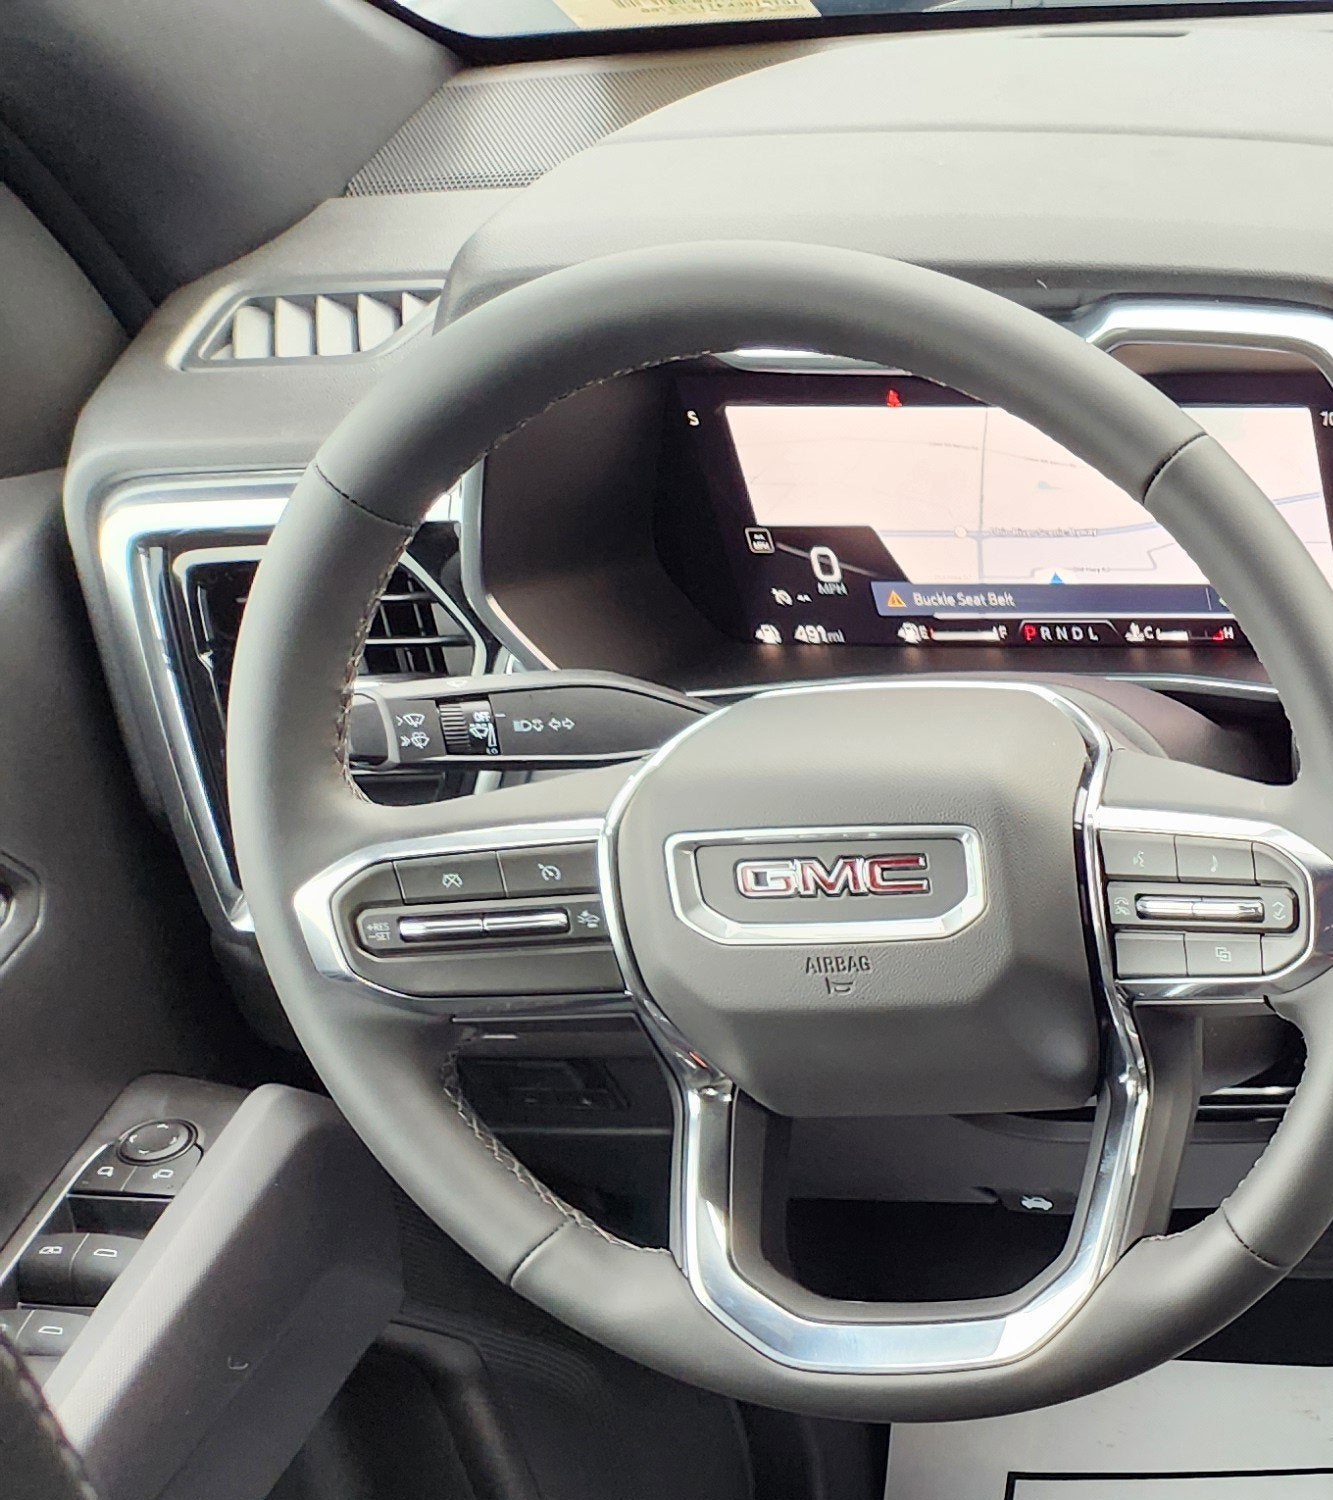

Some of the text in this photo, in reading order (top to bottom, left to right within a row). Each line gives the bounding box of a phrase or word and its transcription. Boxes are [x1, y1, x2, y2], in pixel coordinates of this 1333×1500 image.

[687, 410, 700, 426] S
[810, 546, 842, 582] 0
[817, 582, 848, 595] MPH
[912, 592, 1016, 607] Buckle Seat Belt
[735, 853, 930, 898] GMC
[805, 955, 871, 974] AIRBAG
